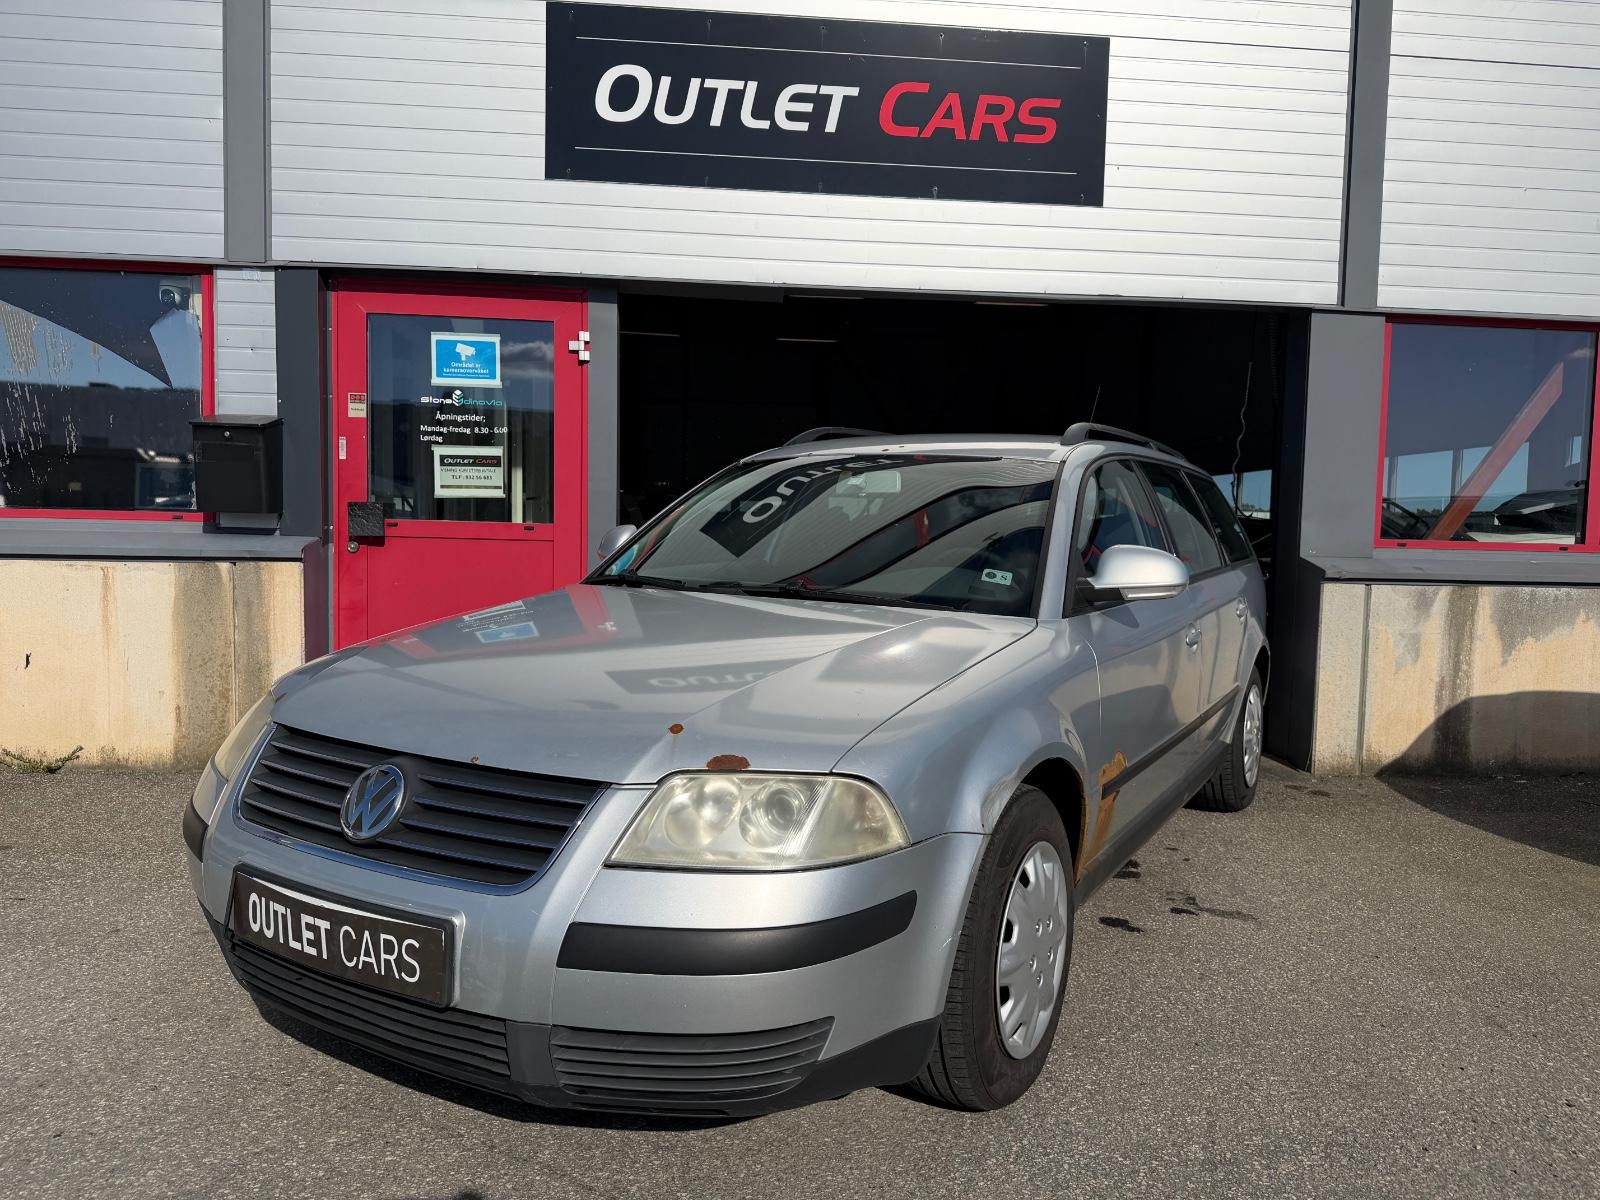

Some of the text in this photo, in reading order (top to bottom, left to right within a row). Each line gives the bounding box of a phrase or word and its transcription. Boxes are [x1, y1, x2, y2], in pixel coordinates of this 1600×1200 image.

[594, 63, 1062, 144] OUTLET CARS
[435, 410, 486, 422] Åpningstider;
[420, 425, 471, 434] Mandag-fredag
[420, 434, 443, 443] Lørdag
[248, 892, 421, 983] OUTLET CARS
